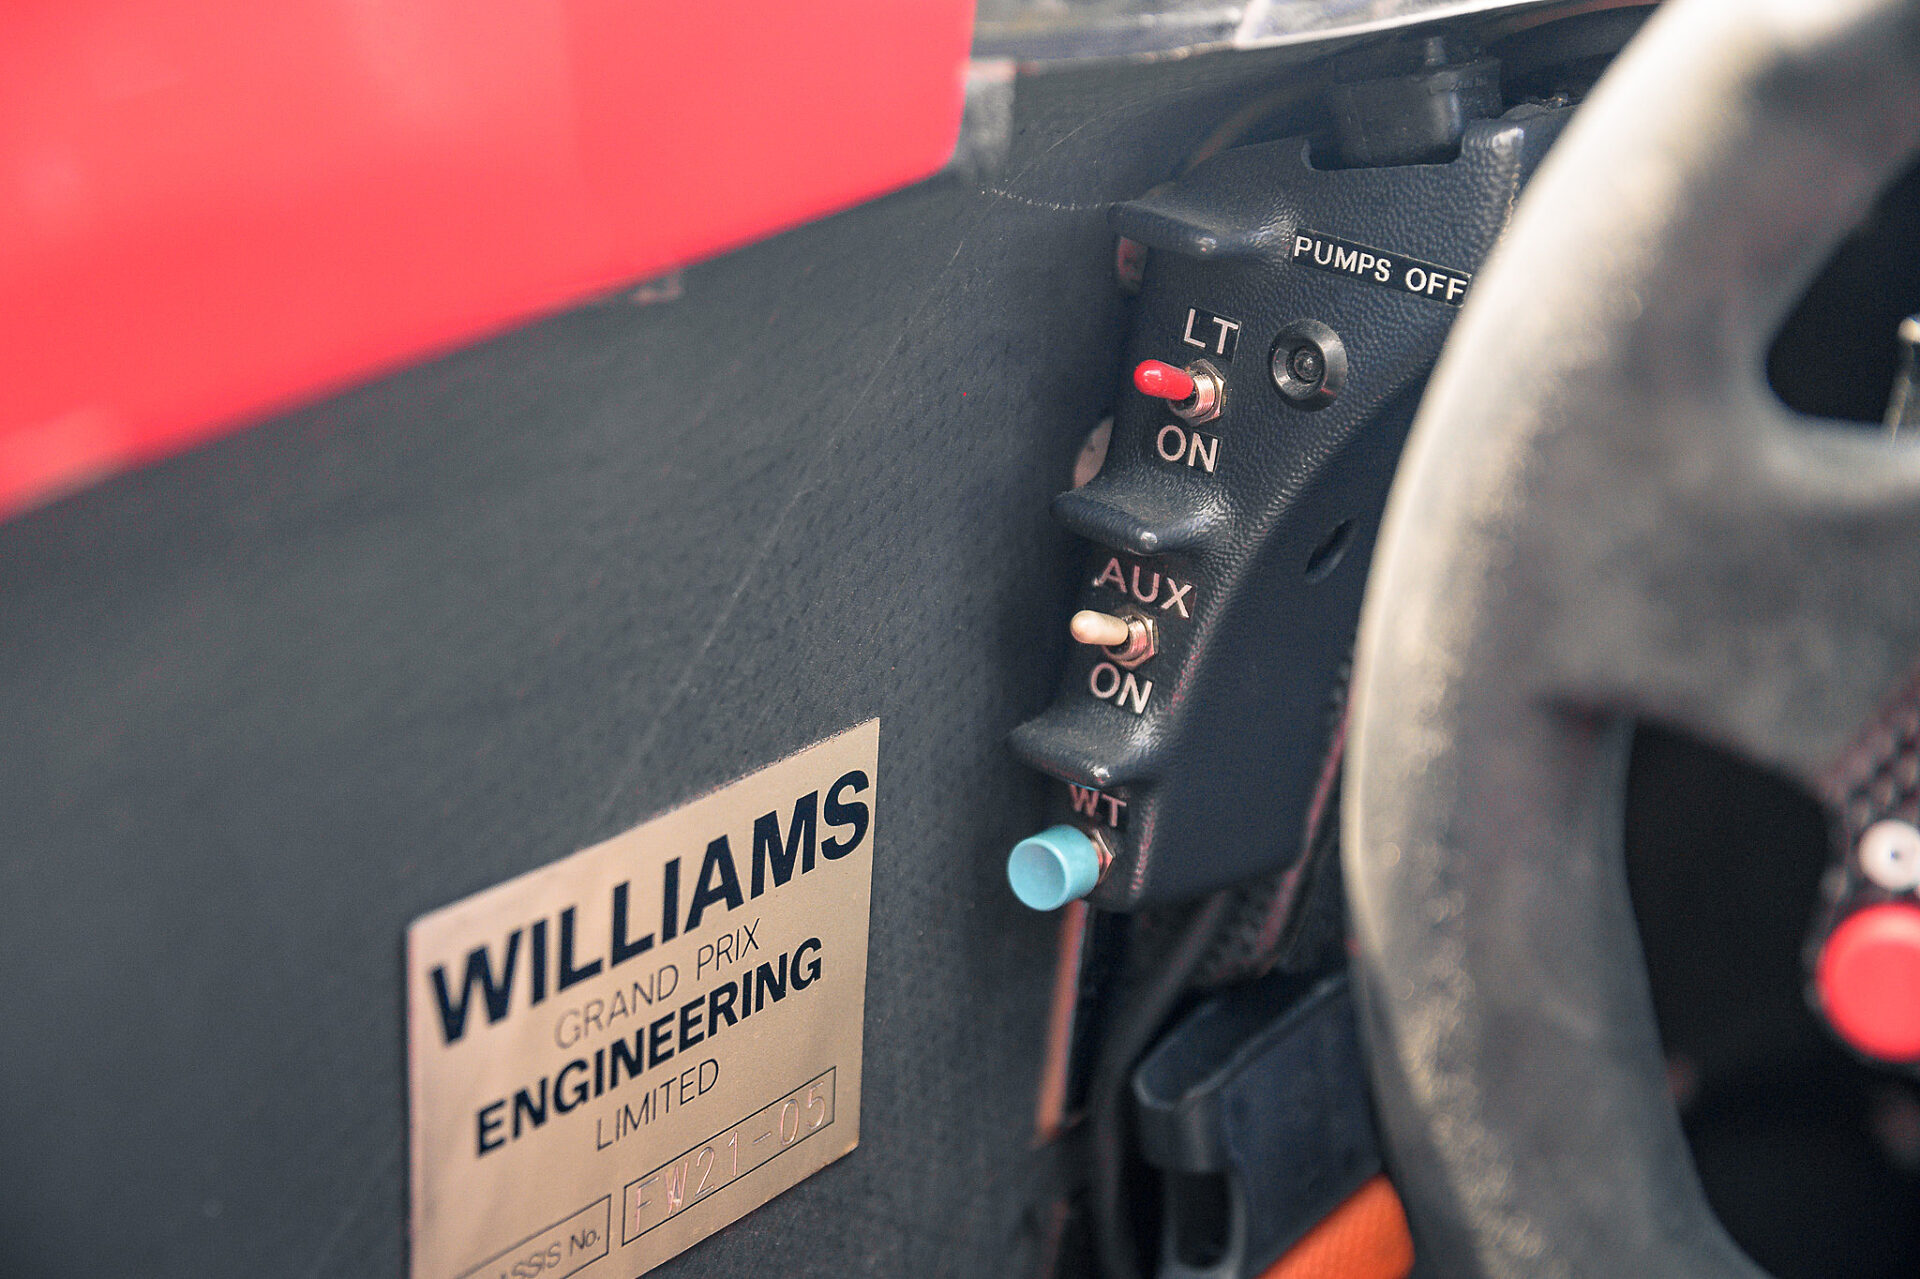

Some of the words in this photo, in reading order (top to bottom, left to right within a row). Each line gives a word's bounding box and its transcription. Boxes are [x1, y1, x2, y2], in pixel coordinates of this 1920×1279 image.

[1294, 235, 1392, 282] PUMPS
[1405, 267, 1468, 300] OFF
[1183, 308, 1239, 355] LT
[1157, 425, 1218, 473] ON
[1098, 557, 1193, 618] AUX
[1090, 662, 1153, 715] ON
[1069, 783, 1127, 828] WT
[428, 769, 870, 1048] WILLIAMS
[553, 965, 679, 1050] GRAND
[696, 918, 761, 980] PRIX
[476, 937, 823, 1159] ENGINEERING
[596, 1058, 720, 1152] LIMITED
[569, 1227, 601, 1256] No.
[632, 1080, 826, 1234] FW21-05
